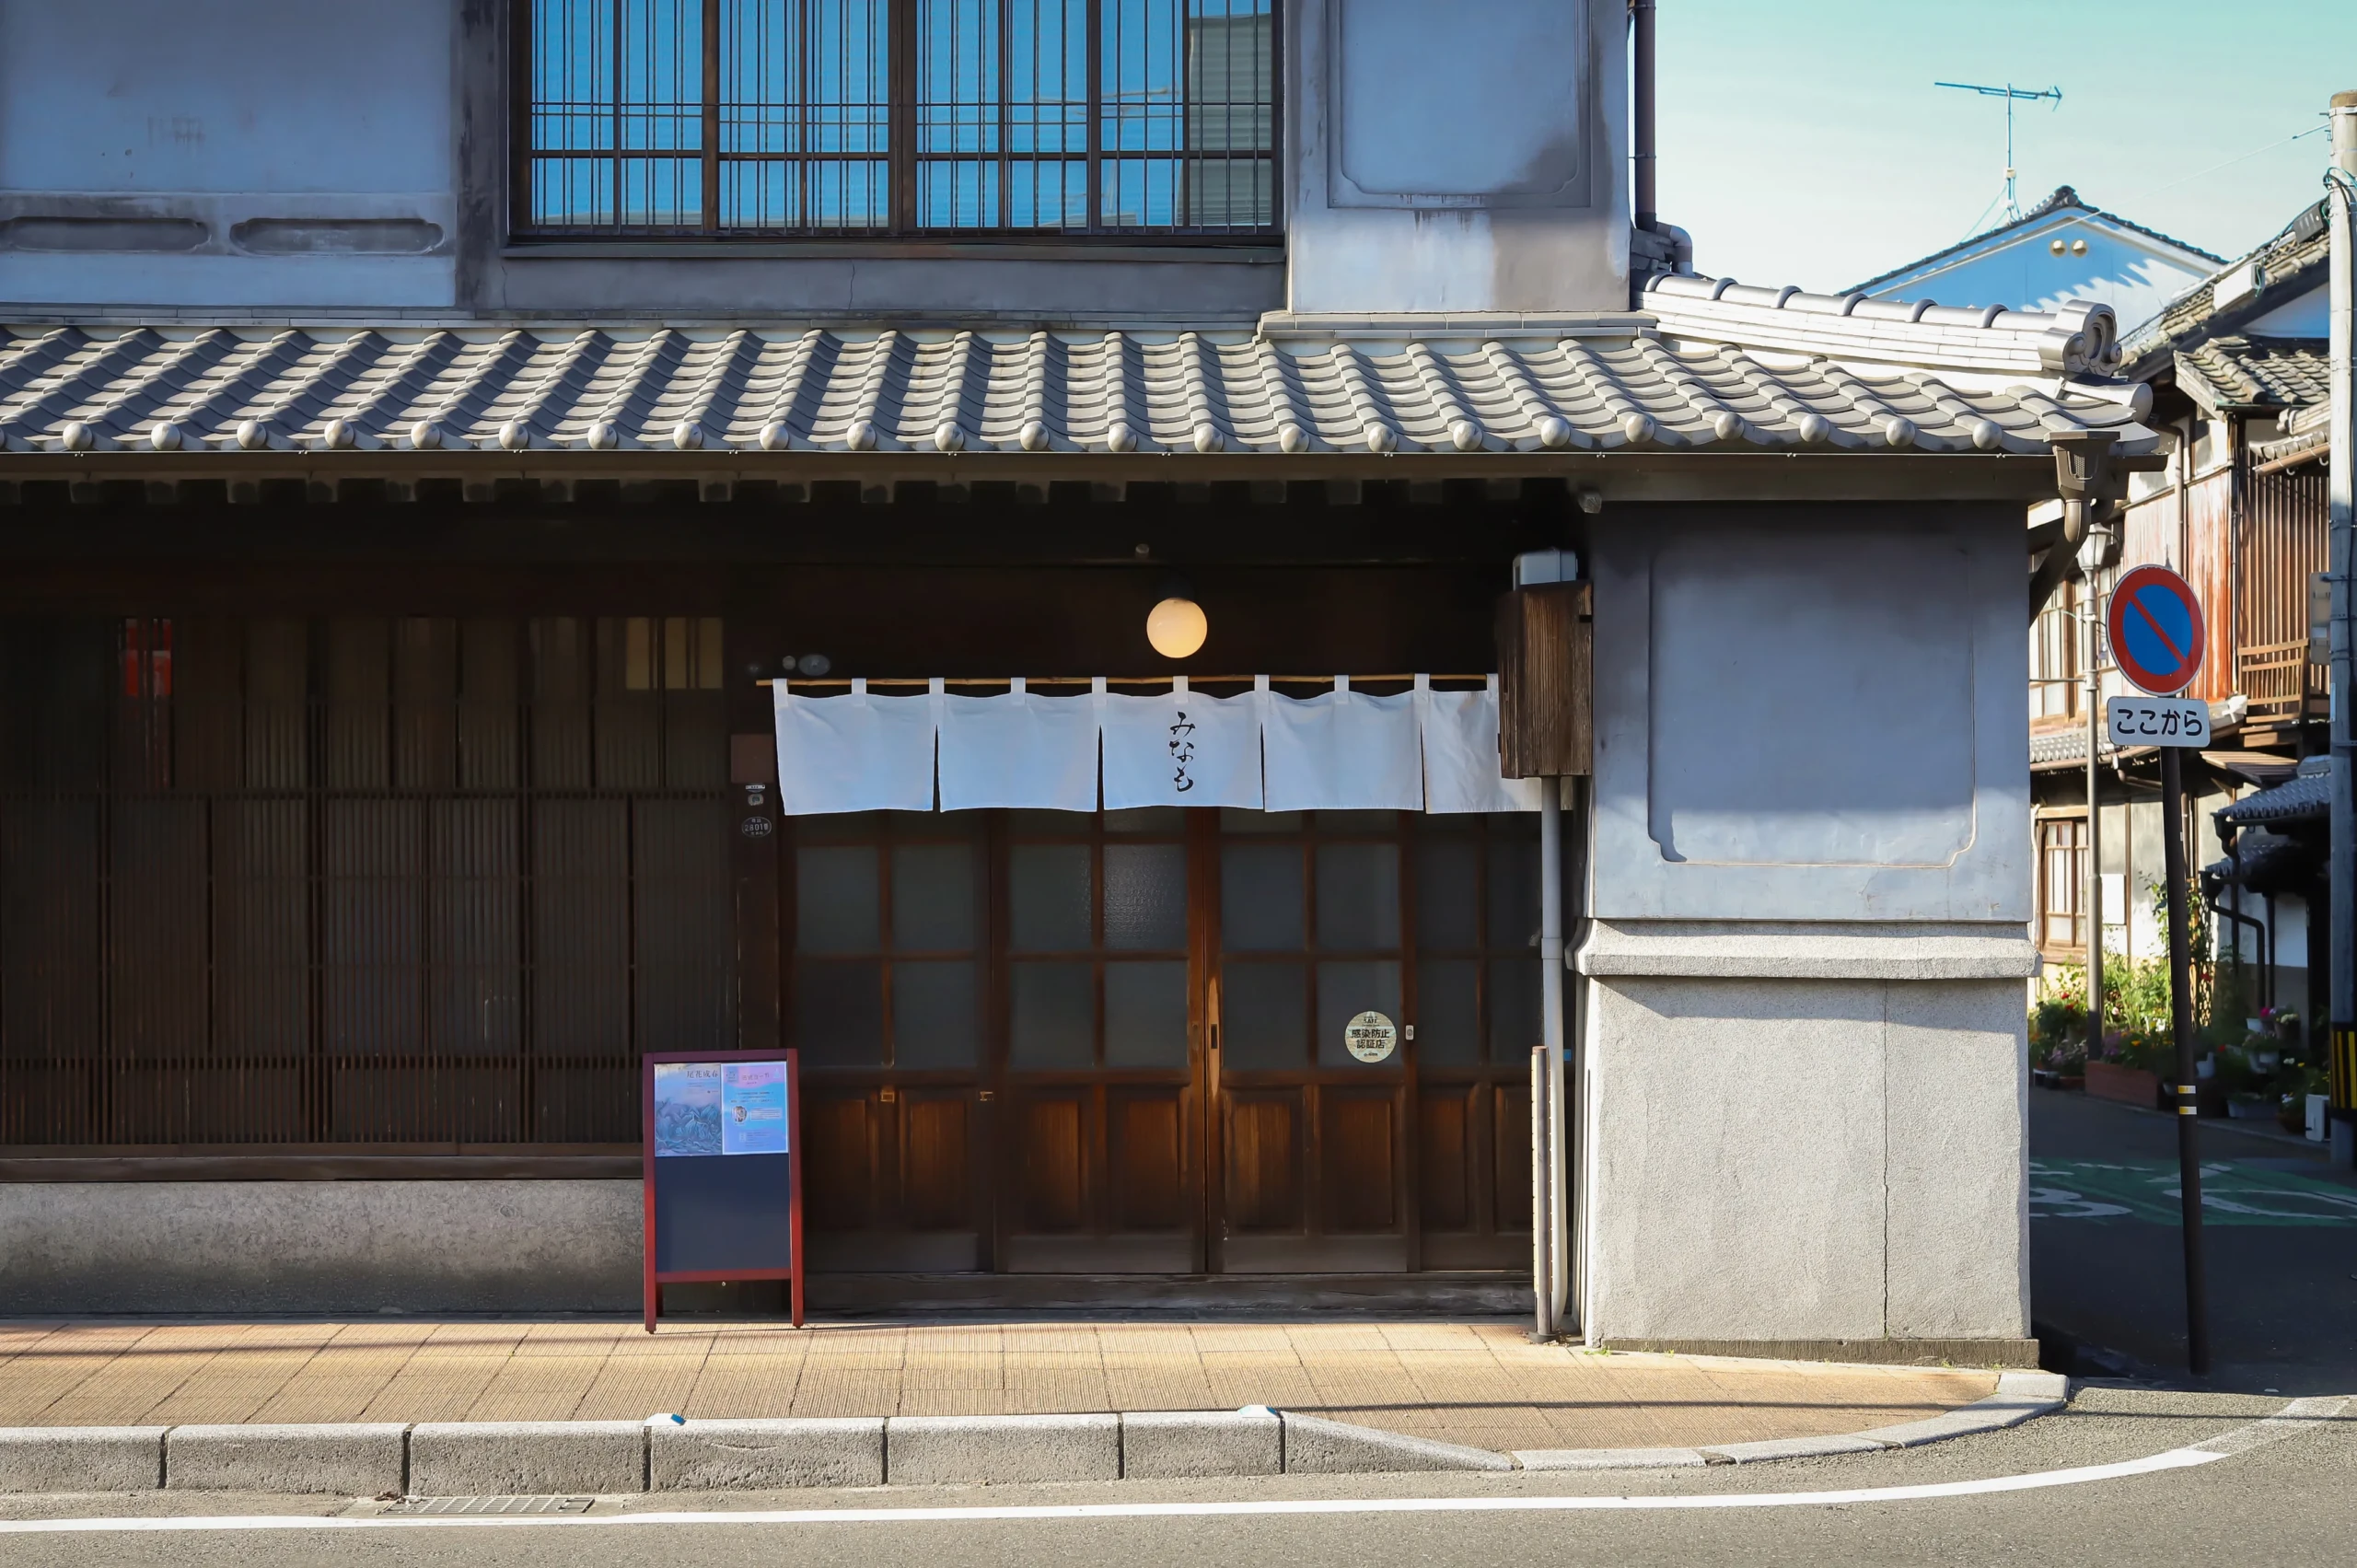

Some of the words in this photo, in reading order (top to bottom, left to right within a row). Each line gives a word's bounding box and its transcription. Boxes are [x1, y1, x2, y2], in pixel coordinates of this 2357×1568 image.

[2116, 708, 2203, 737] ここから
[1168, 711, 1196, 793] みなも
[1351, 1028, 1390, 1039] 感染防止
[1356, 1039, 1386, 1049] 認証店
